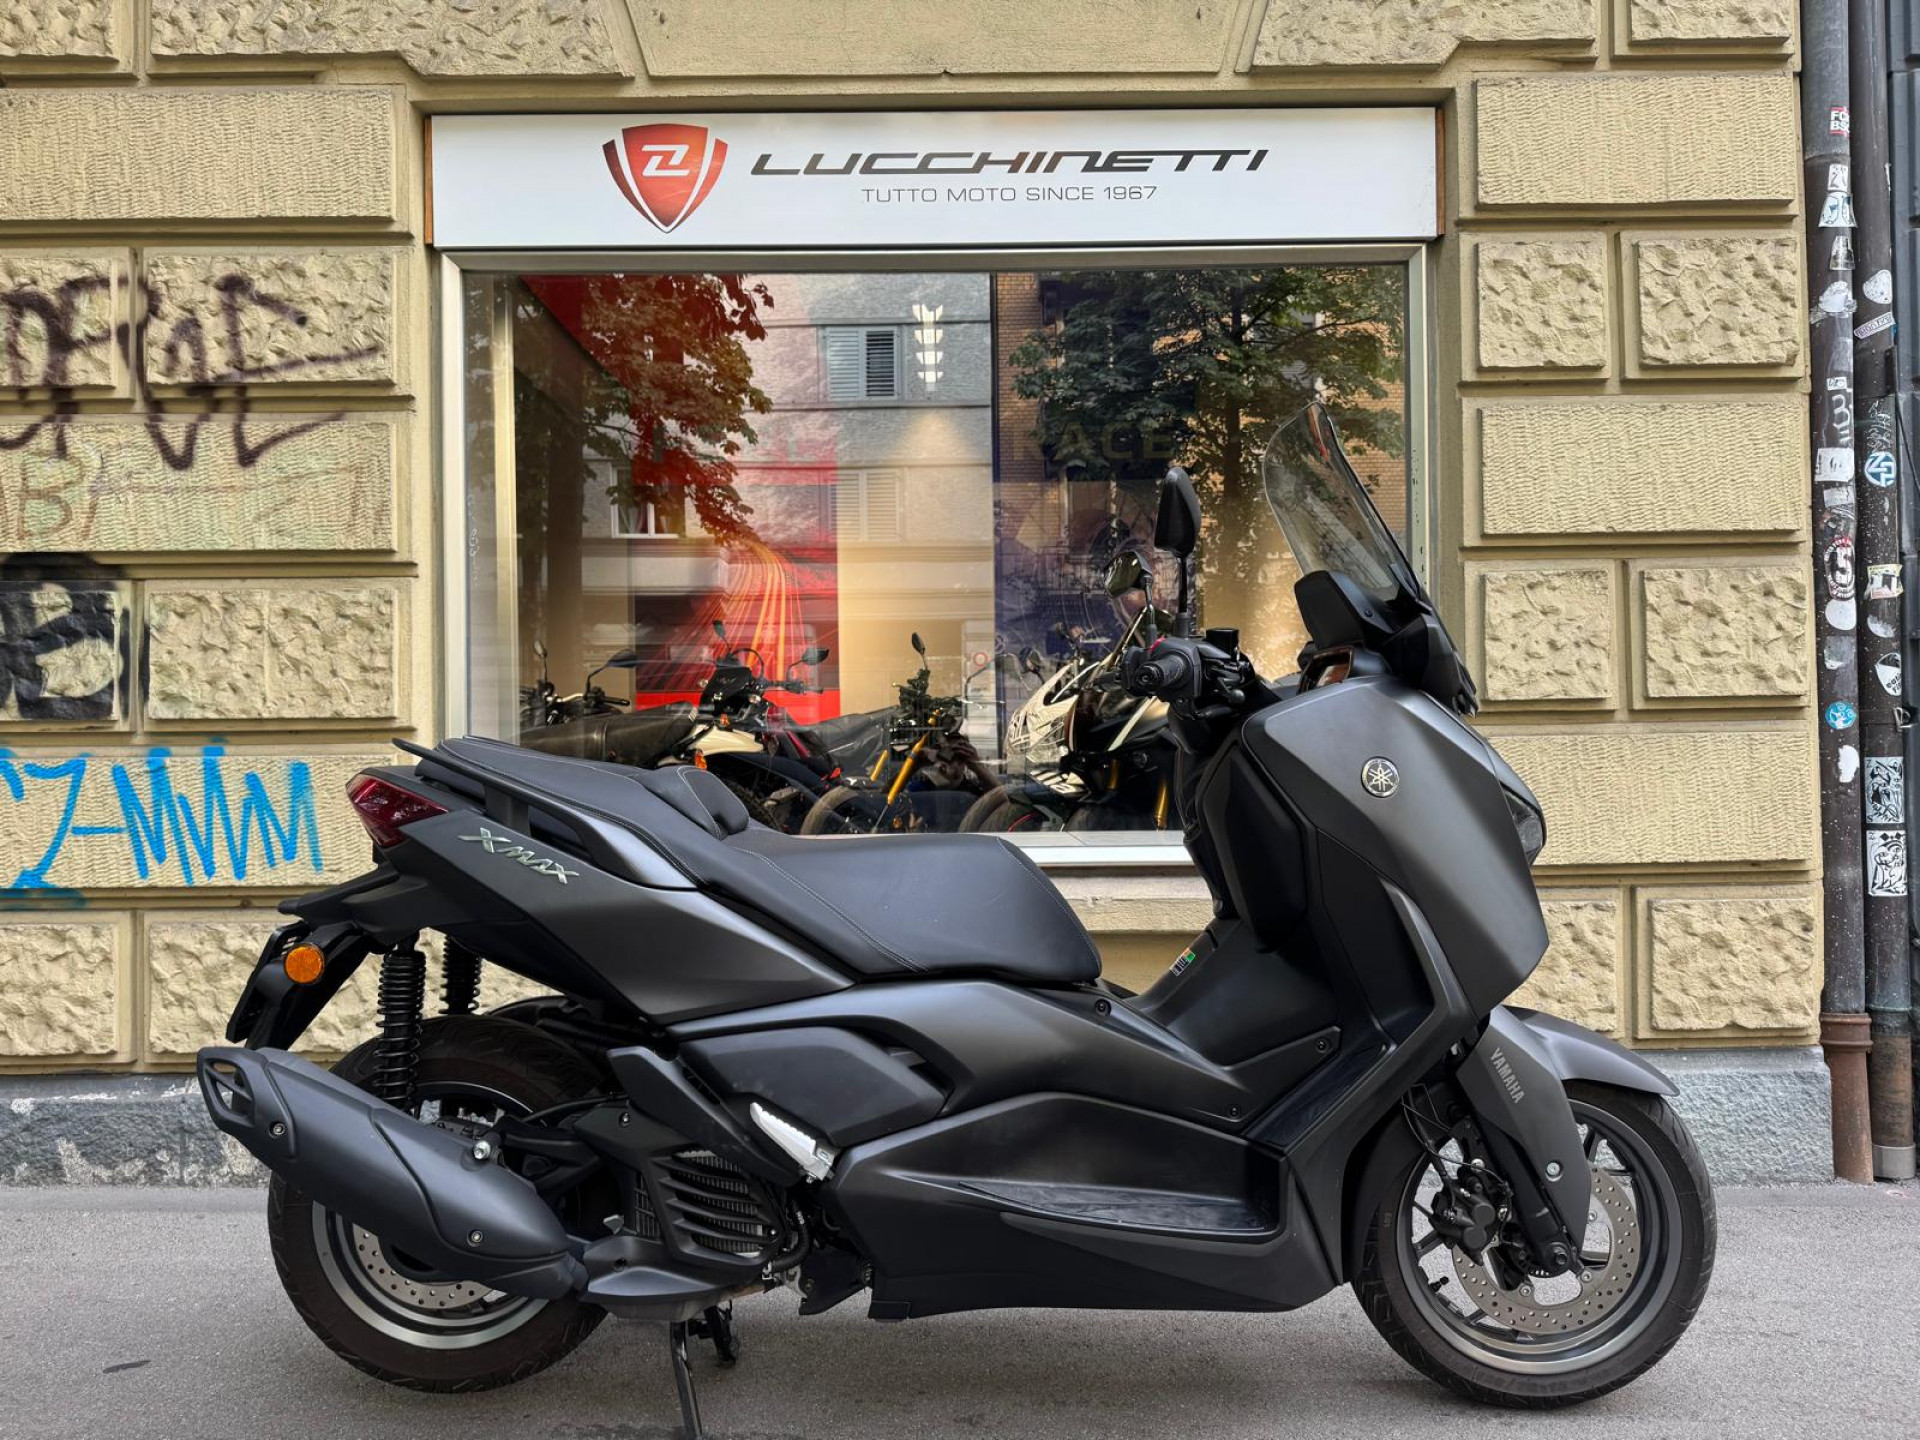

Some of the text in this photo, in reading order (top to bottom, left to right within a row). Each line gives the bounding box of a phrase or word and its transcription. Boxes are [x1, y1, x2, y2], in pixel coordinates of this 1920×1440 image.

[752, 149, 1269, 175] LUCCHINETTI
[862, 186, 1158, 202] TUTTO MOTO SINCE 1967
[1491, 1048, 1525, 1104] YAMAHA
